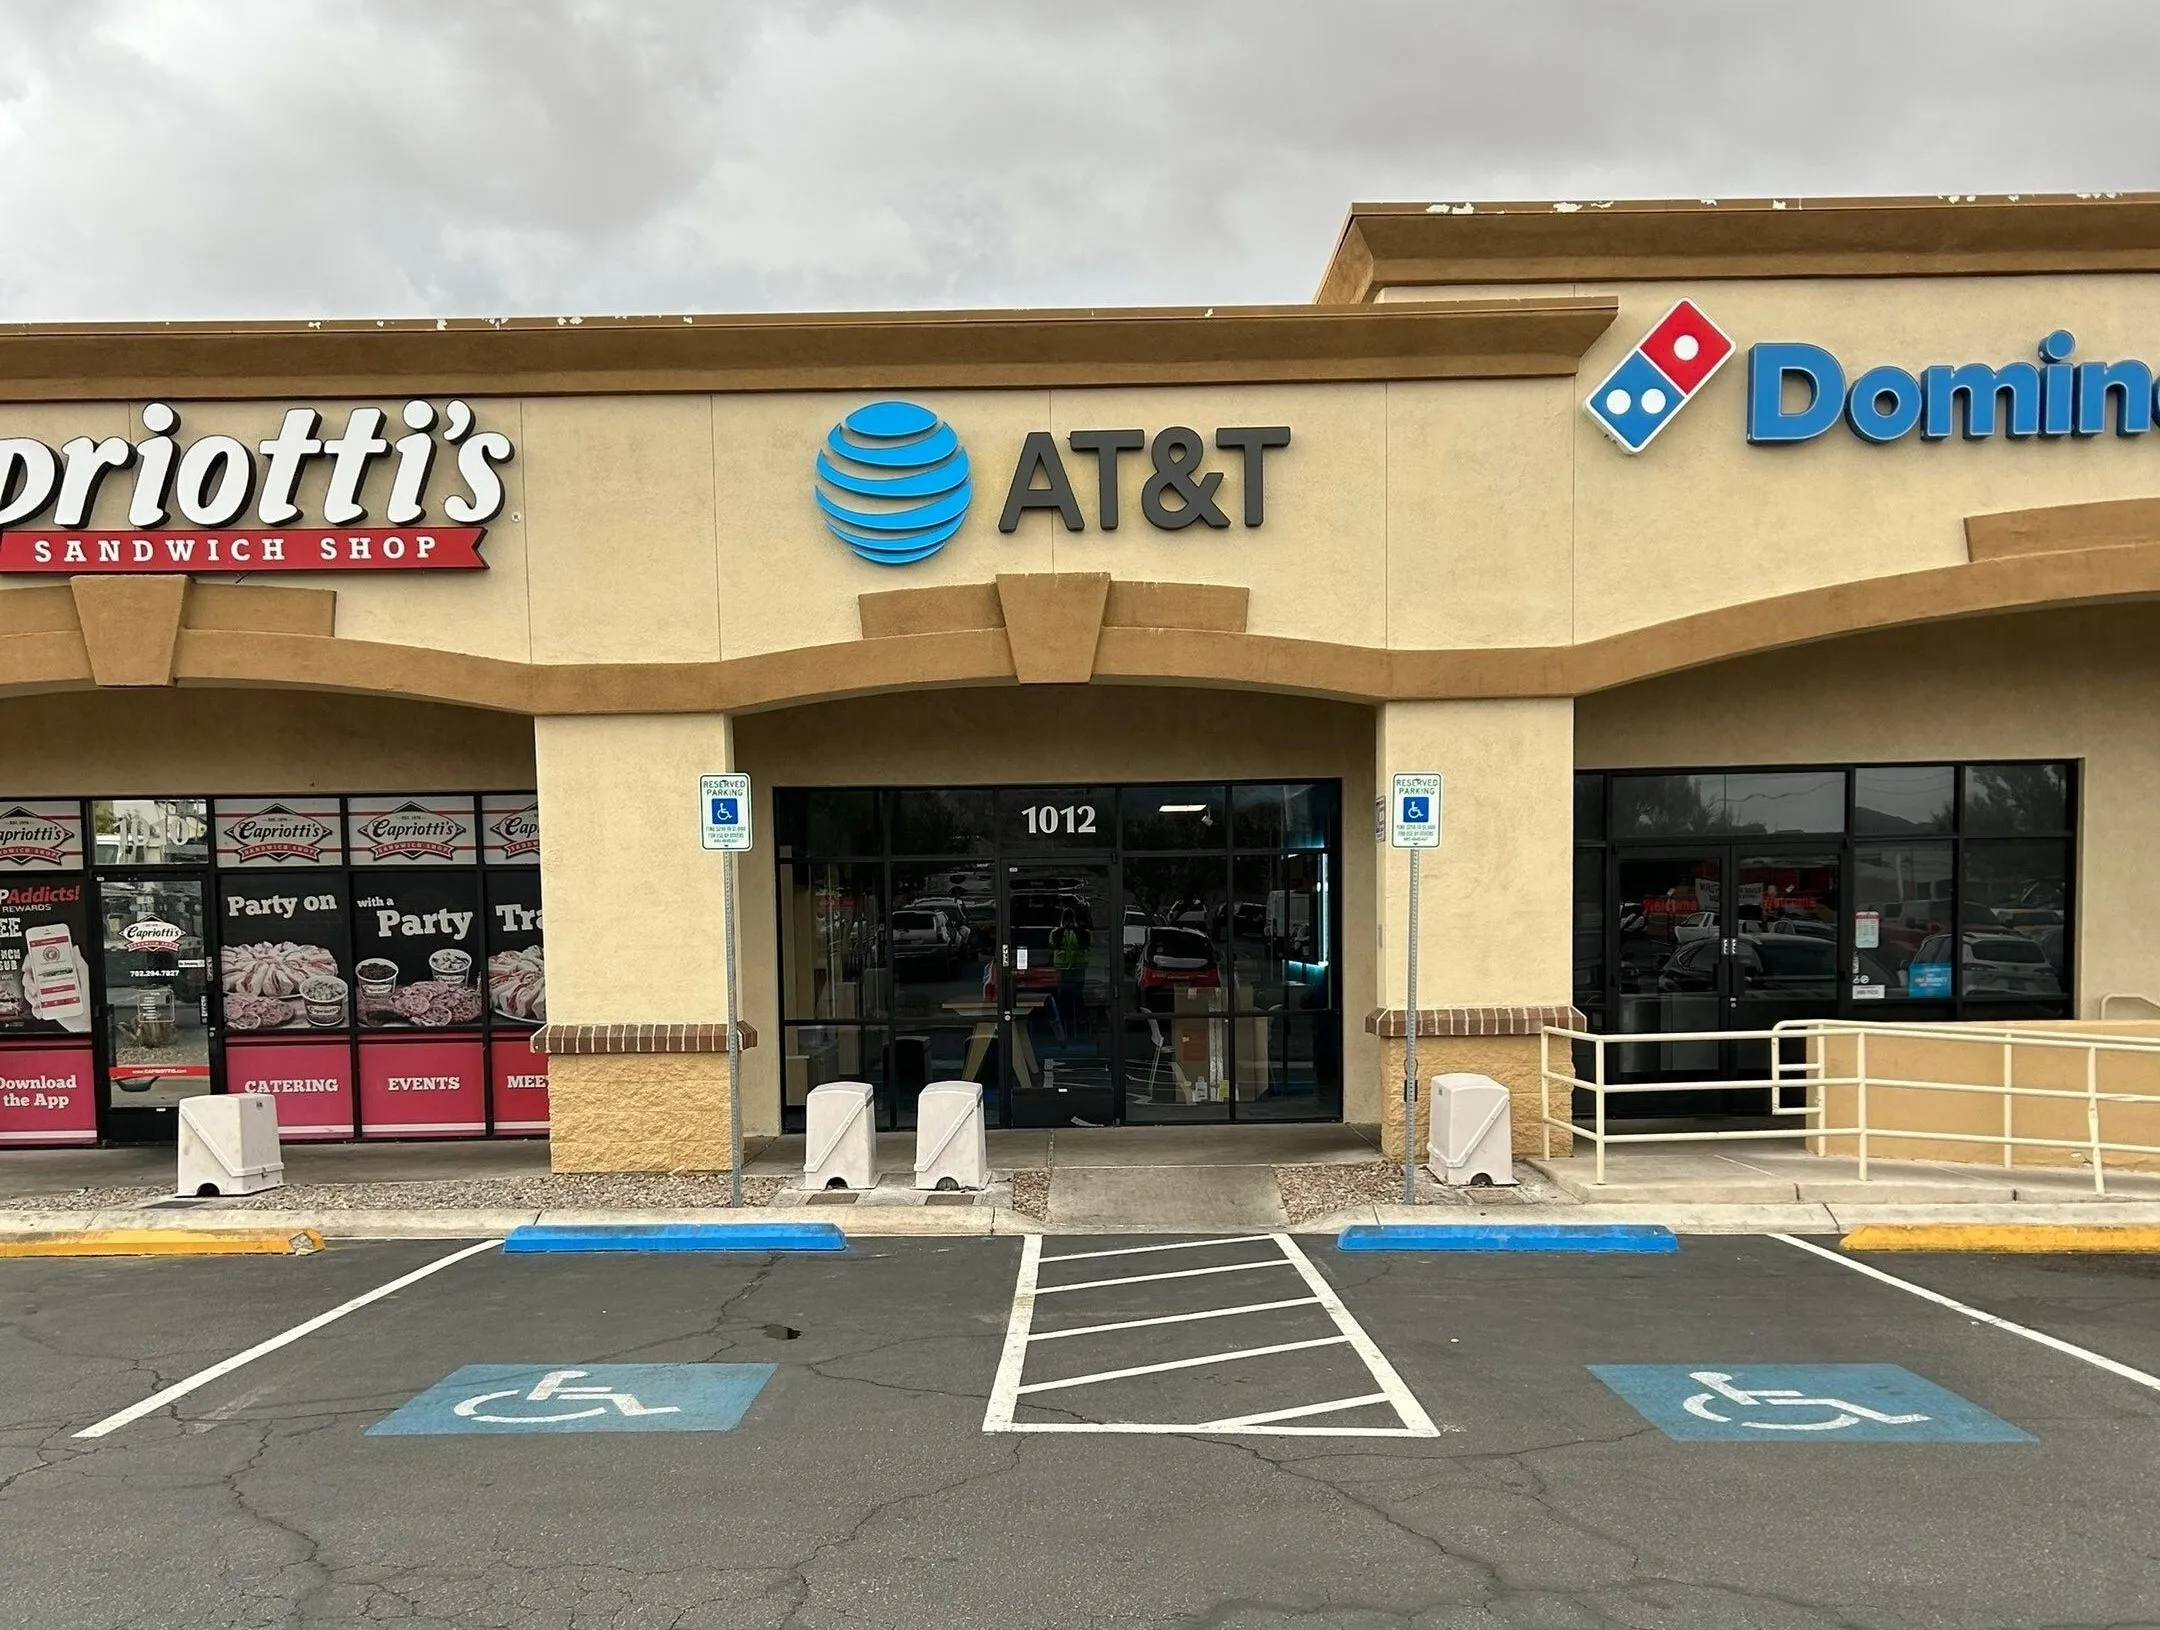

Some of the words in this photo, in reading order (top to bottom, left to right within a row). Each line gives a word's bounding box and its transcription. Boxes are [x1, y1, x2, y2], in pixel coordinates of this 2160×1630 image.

[1748, 329, 2160, 445] Domin
[998, 426, 1291, 533] AT&T
[33, 537, 286, 562] SANDWICH
[320, 535, 438, 560] SHOP
[703, 780, 746, 788] RESERVED
[706, 788, 743, 797] PARKING
[1395, 779, 1438, 787] RESERVED
[1398, 787, 1435, 795] PARKING
[372, 818, 453, 840] Capriotti's
[505, 817, 539, 838] Cap
[1021, 805, 1096, 834] 1012
[112, 816, 190, 847] 1010
[239, 820, 320, 842] Capriotti's
[2, 903, 52, 913] REWARDS
[227, 895, 298, 919] Party
[303, 894, 337, 911] on
[356, 897, 386, 908] with
[386, 899, 395, 907] a
[127, 925, 180, 939] Capriotti's
[376, 907, 474, 941] Party
[244, 1078, 339, 1093] CATERING
[388, 1076, 460, 1091] EVENTS
[3, 1092, 30, 1107] the
[33, 1092, 70, 1110] App
